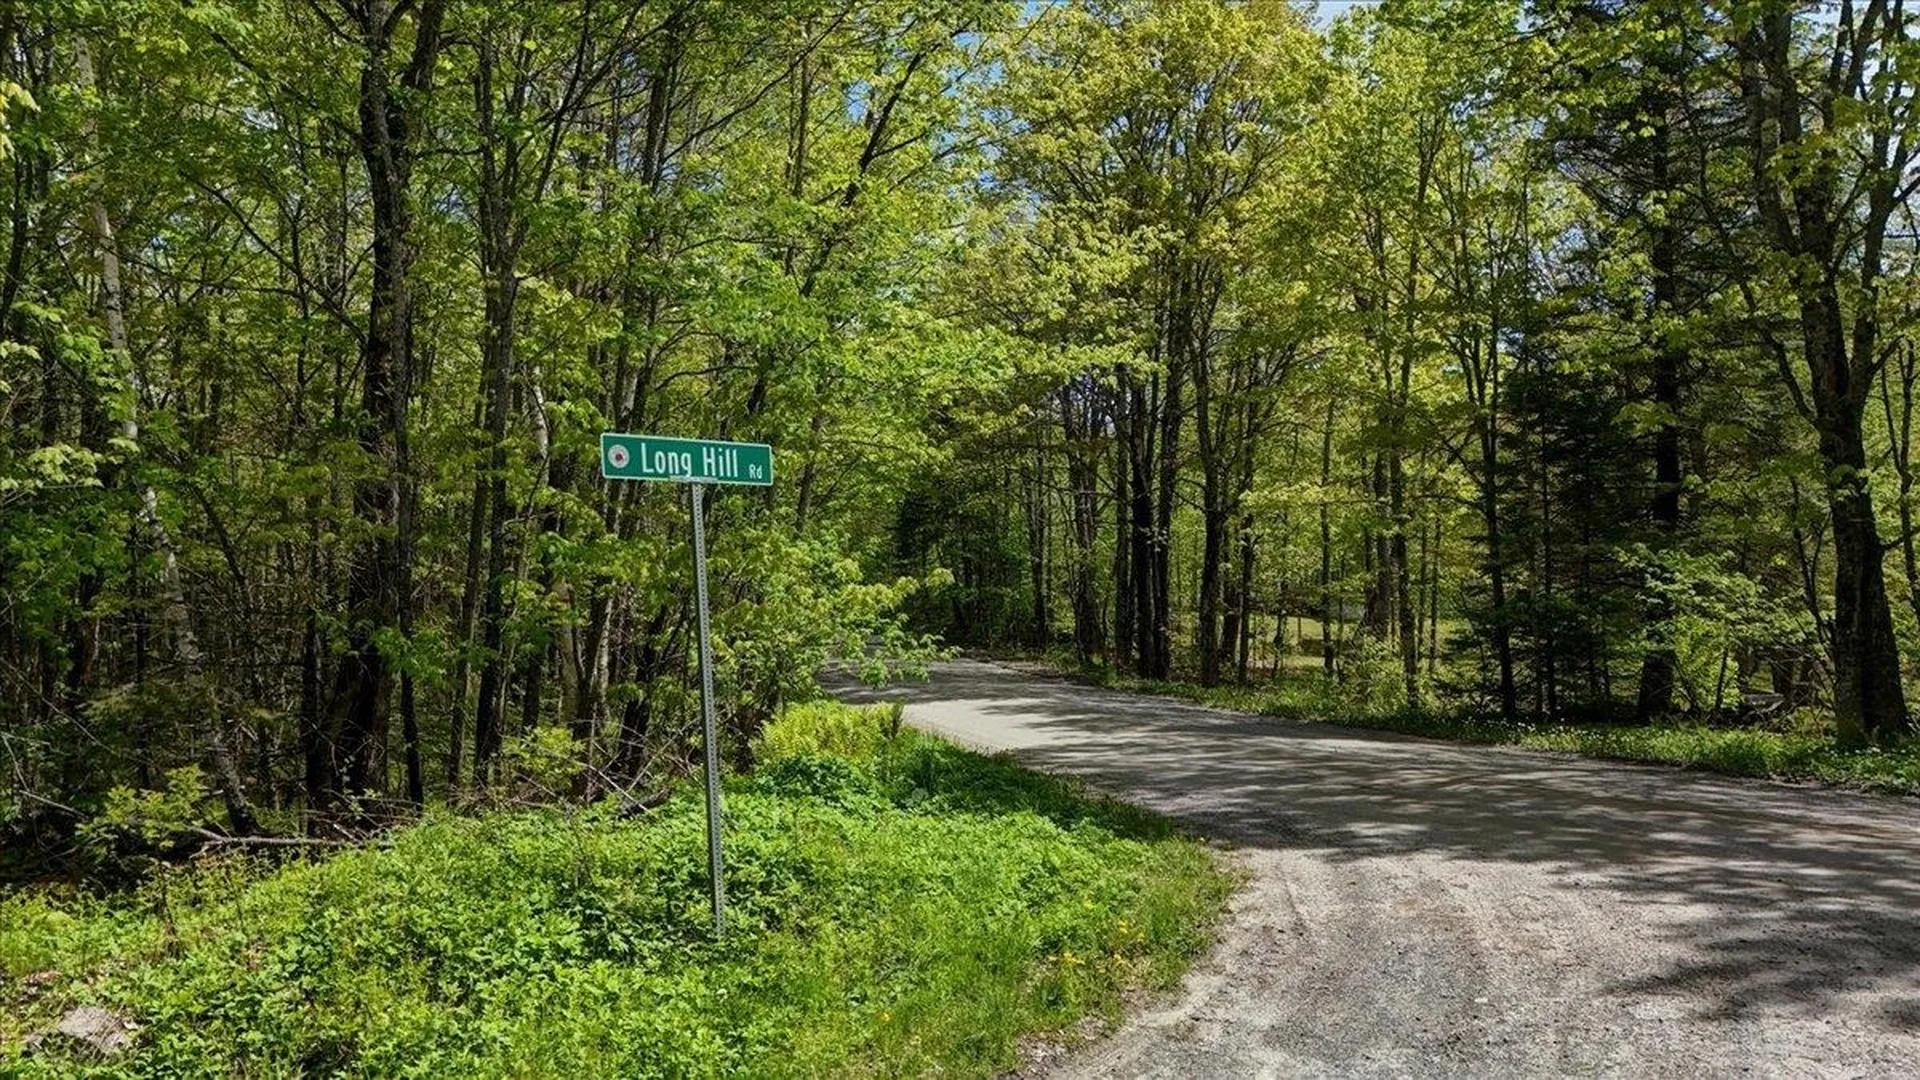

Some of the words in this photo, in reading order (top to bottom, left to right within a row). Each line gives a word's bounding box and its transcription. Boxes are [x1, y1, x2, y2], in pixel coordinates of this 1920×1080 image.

[641, 442, 692, 477] Long
[702, 446, 739, 478] Hill
[749, 464, 763, 480] Rd
